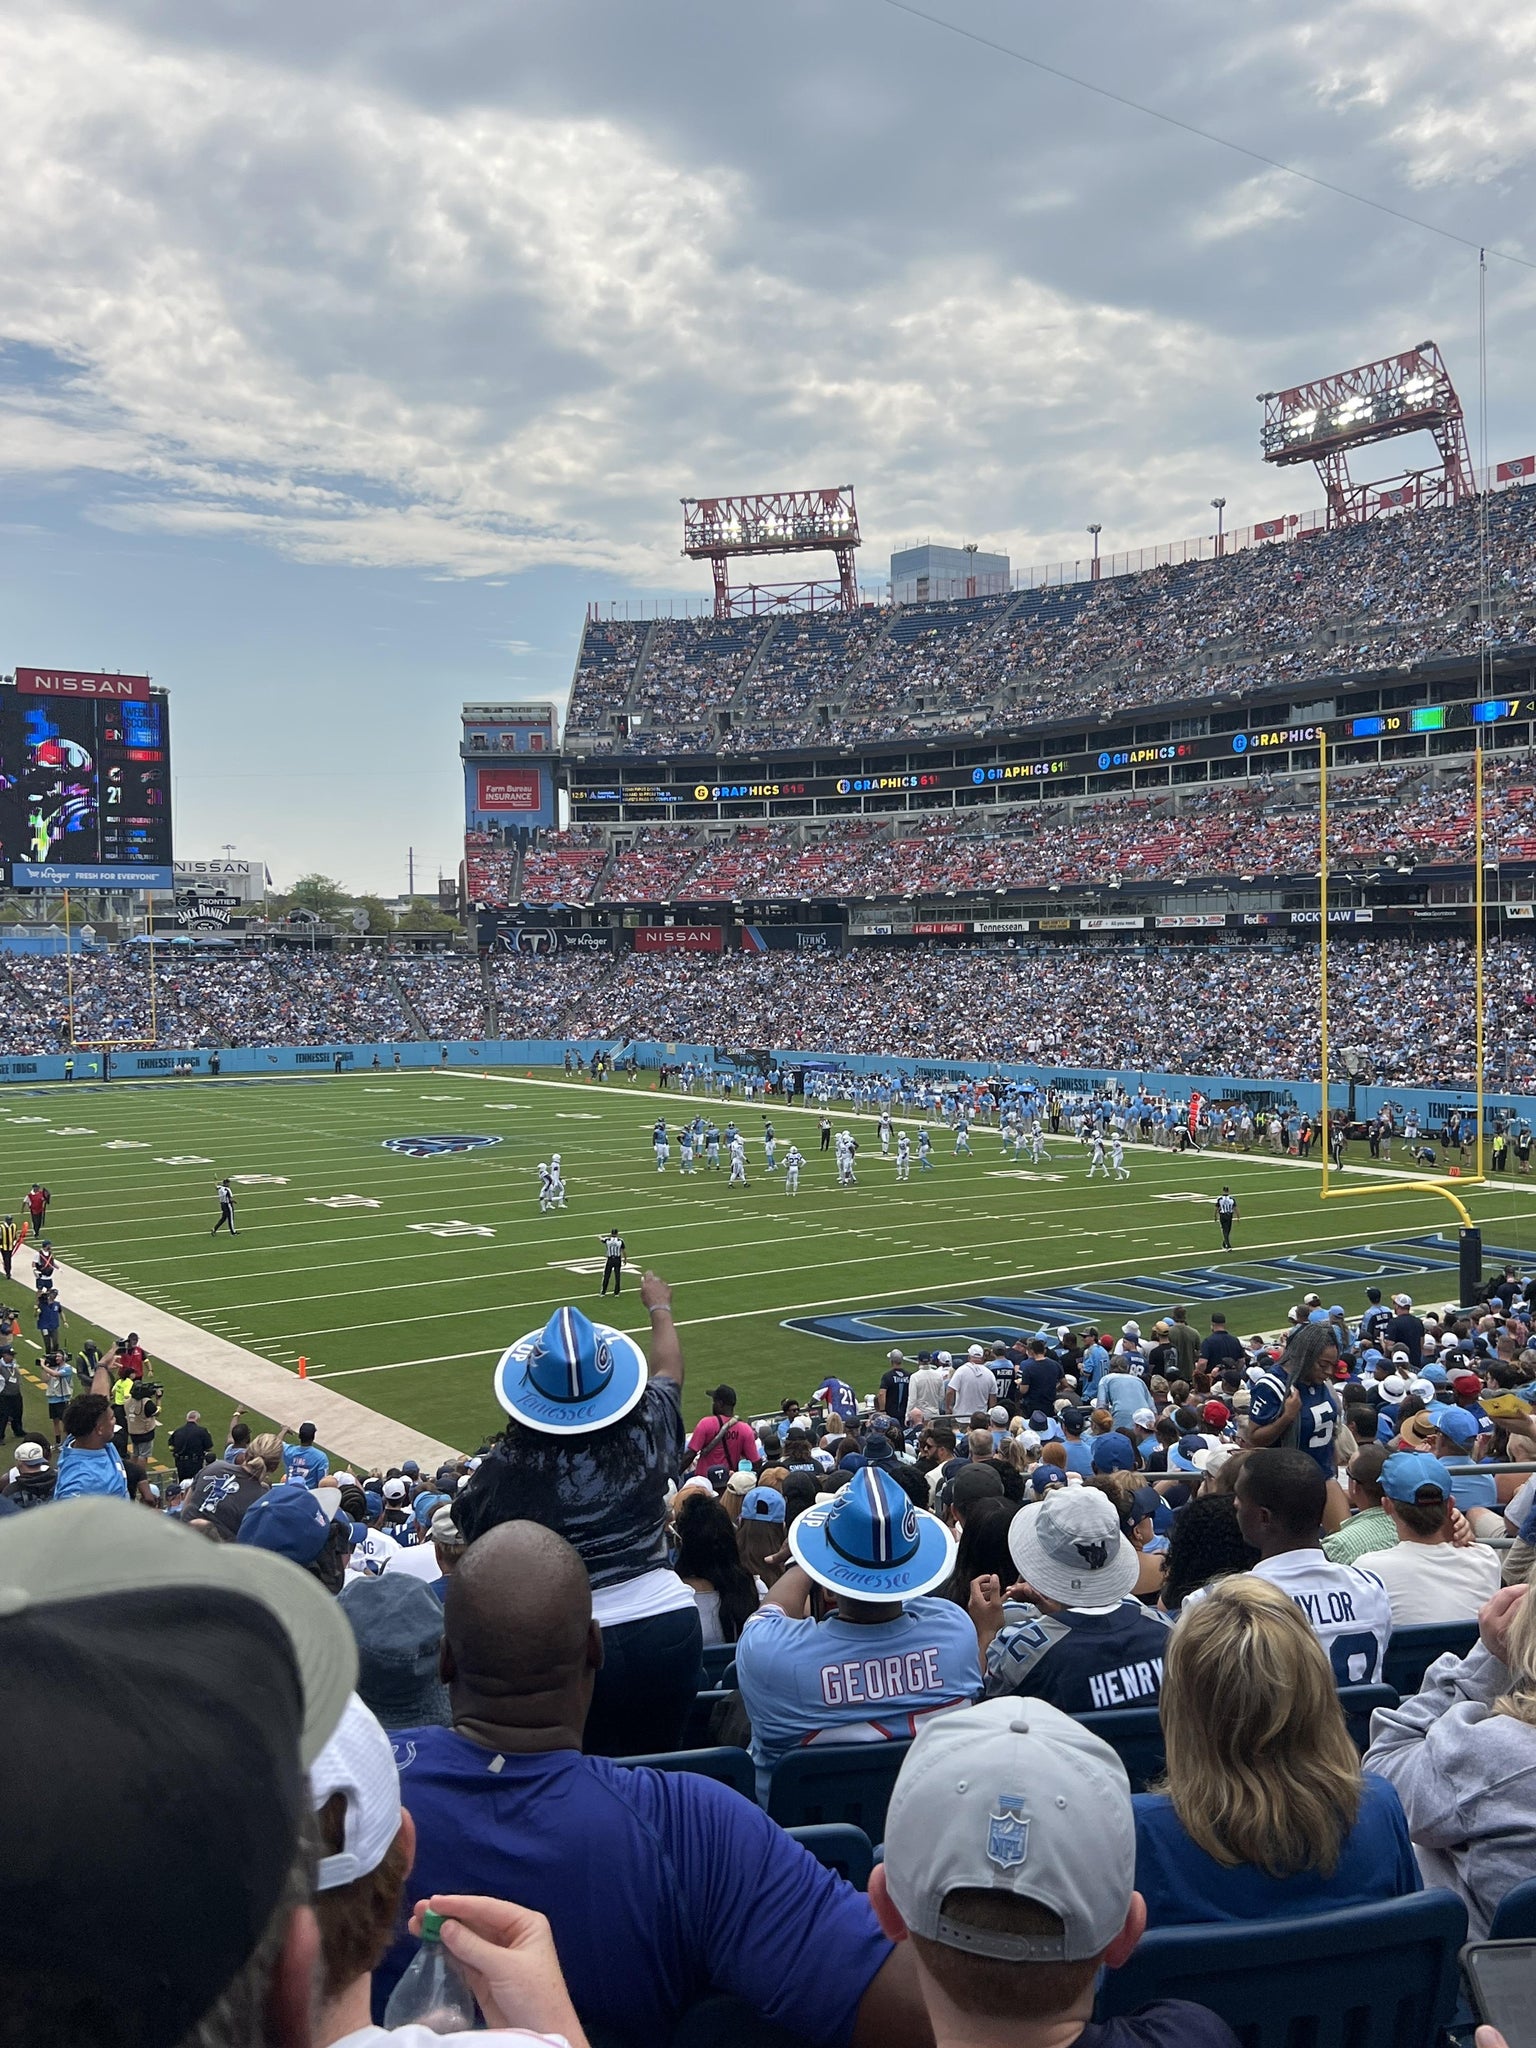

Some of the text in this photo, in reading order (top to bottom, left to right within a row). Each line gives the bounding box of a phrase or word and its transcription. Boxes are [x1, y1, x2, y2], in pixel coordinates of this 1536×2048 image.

[35, 676, 133, 694] NISSAN
[1509, 701, 1518, 717] 7
[1386, 717, 1400, 730] 10
[1250, 727, 1323, 747] GRAPHICS
[1113, 746, 1175, 765] GRAPHICS
[988, 763, 1049, 780] GRAPHICS
[712, 785, 780, 798] GRAPHICS
[783, 784, 805, 794] 615
[854, 776, 918, 791] GRAPHICS
[107, 786, 121, 804] 21
[41, 867, 70, 883] Kroger
[174, 862, 249, 873] NISSAN
[177, 907, 198, 924] JACK
[1243, 914, 1269, 924] FedEx
[1328, 912, 1351, 921] LAW
[578, 933, 607, 950] Kroger
[646, 932, 711, 941] NISSAN
[137, 1057, 175, 1069] TENNESSEE
[839, 1387, 854, 1406] 21
[517, 1391, 596, 1421] Tennessee
[1309, 1401, 1334, 1448] 5
[715, 1469, 724, 1479] T
[789, 1463, 815, 1472] SIMMONS
[827, 1561, 911, 1589] Tennessee
[820, 1647, 943, 1706] GEORGE
[1088, 1656, 1164, 1709] HENRY
